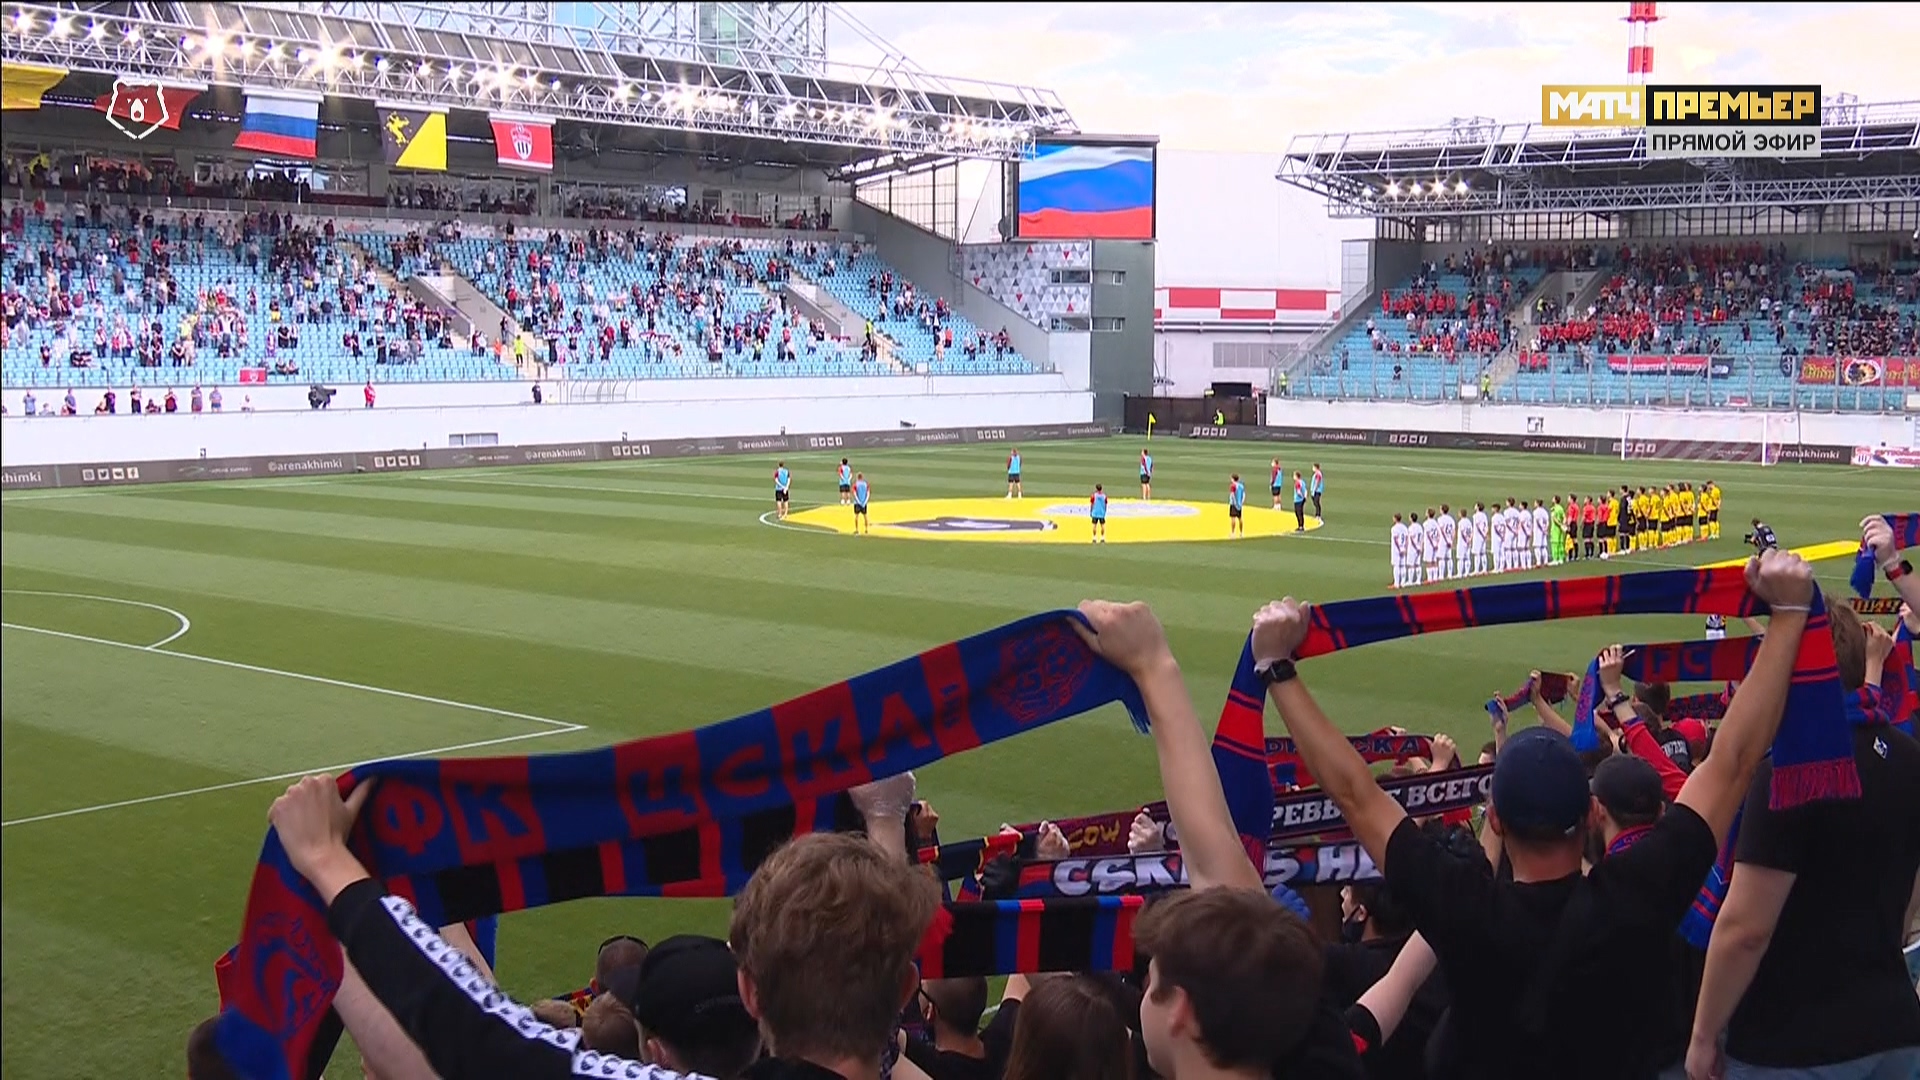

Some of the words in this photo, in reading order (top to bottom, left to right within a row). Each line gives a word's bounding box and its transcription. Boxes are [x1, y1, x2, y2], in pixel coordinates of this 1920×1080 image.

[1311, 432, 1367, 442] @arenakhimki
[1523, 439, 1586, 450] @arenakhimki
[525, 447, 586, 461] @arenakhimki
[268, 457, 343, 473] @arenakhimki
[371, 778, 531, 857] ФК
[627, 690, 933, 816] ЦСКА
[1053, 855, 1190, 896] CSK
